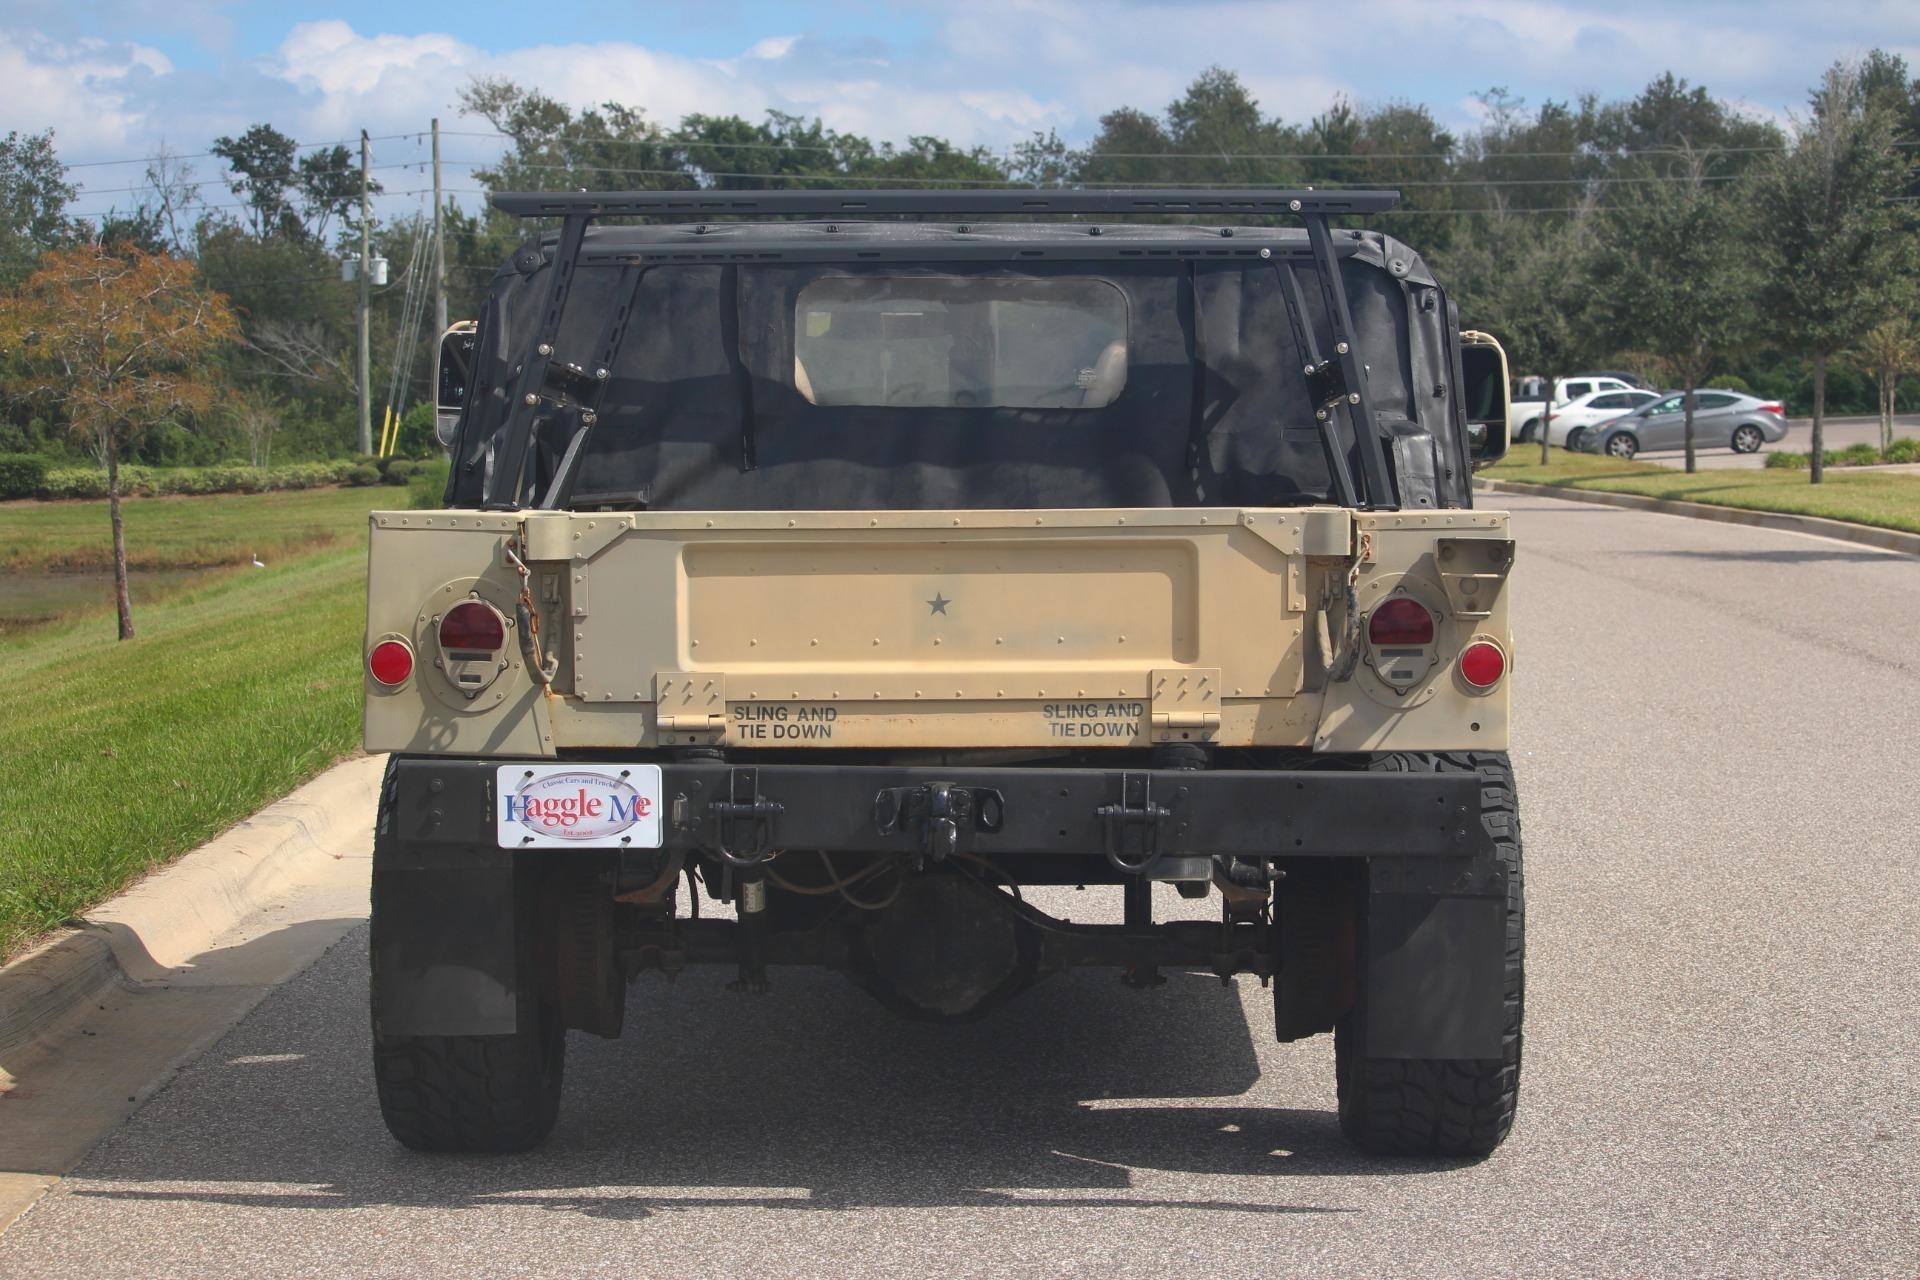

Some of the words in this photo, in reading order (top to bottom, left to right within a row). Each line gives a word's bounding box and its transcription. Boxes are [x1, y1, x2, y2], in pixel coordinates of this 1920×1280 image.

[734, 706, 788, 721] SLING
[797, 707, 837, 721] AND
[1043, 704, 1098, 719] SLING
[1105, 703, 1144, 718] AND
[738, 724, 766, 739] TIE
[773, 724, 831, 739] DOWN
[1049, 722, 1075, 737] TIE
[1080, 722, 1139, 737] DOWN
[504, 788, 602, 827] Haggle
[608, 794, 652, 822] Me
